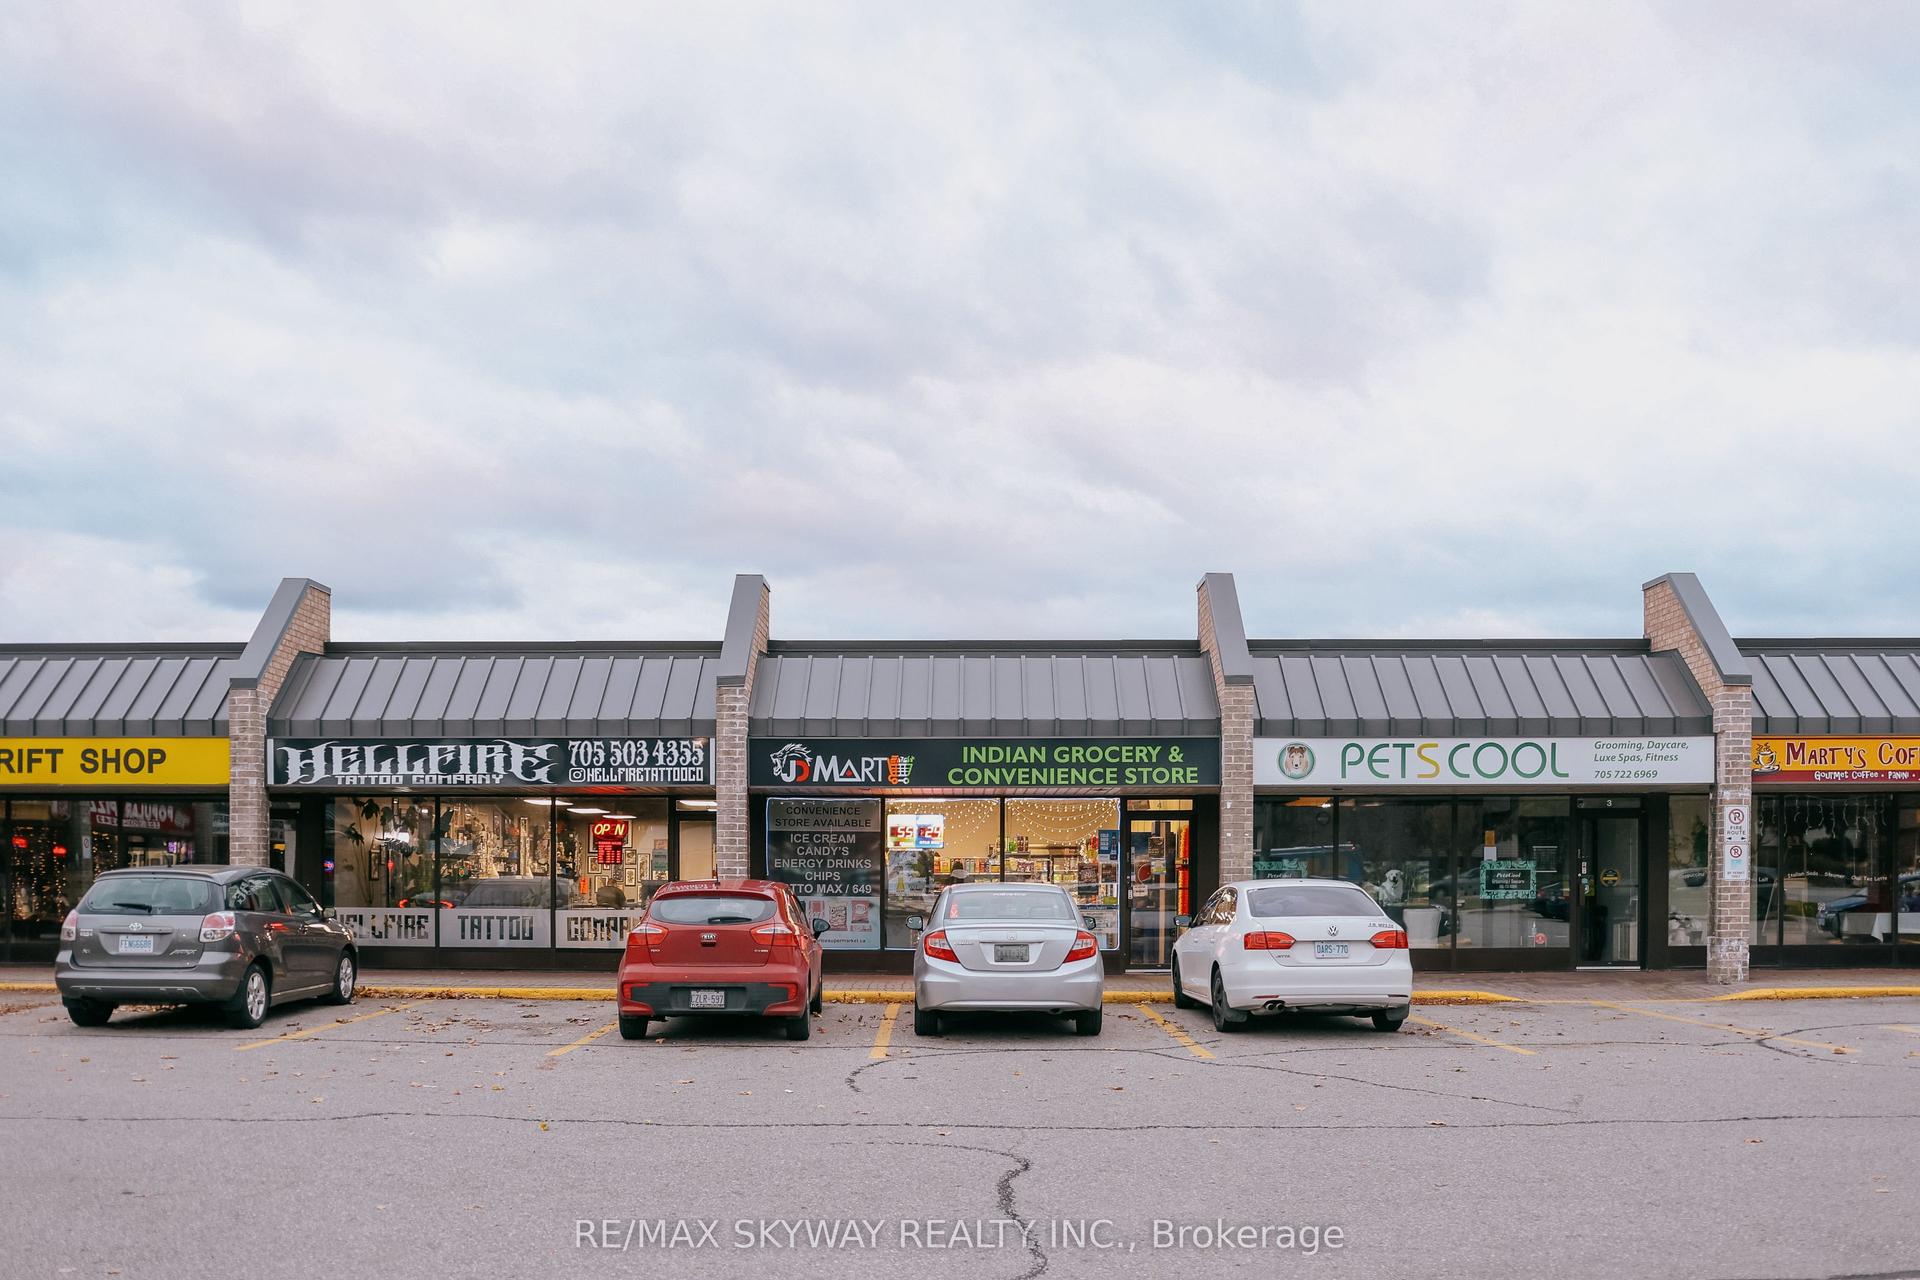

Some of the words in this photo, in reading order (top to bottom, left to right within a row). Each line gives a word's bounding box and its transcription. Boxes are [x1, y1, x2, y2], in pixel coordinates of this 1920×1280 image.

[1594, 740, 1644, 752] Grooming,
[1646, 740, 1689, 751] Daycare,
[568, 740, 605, 767] 705
[610, 740, 649, 767] 503
[652, 740, 704, 767] 4355
[962, 746, 1046, 764] INDIAN
[1053, 746, 1161, 764] GROCERY
[1168, 746, 1184, 763] &
[1594, 753, 1616, 762] Luxe
[1618, 753, 1643, 763] Spas,
[1645, 753, 1679, 762] Fitness
[1878, 742, 1920, 765] COF
[80, 748, 166, 774] SHOP
[277, 740, 559, 784] HELLFIRE
[1448, 742, 1569, 778] COOL
[587, 767, 704, 782] HELLFIRETATTOOCO
[812, 755, 889, 782] MART
[1594, 770, 1612, 779] 705
[1614, 770, 1632, 779] 722
[1633, 770, 1658, 779] 6969
[334, 775, 403, 785] TATTOO
[412, 774, 503, 785] COMPANY
[947, 767, 1118, 785] CONVENIENCE
[1125, 767, 1199, 784] STORE
[1606, 799, 1613, 807] 3
[786, 806, 861, 815] CONVENIENCE
[593, 823, 626, 836] OPN
[775, 819, 810, 827] STORE
[812, 819, 871, 828] AVAILABLE
[790, 833, 810, 843] ICE
[813, 833, 856, 844] CREAM
[796, 846, 850, 856] CANDY'S
[774, 858, 823, 868] ENERGY
[827, 858, 872, 869] DRINKS
[805, 871, 841, 881] CHIPS
[789, 883, 813, 894] TTO
[816, 883, 844, 894] MAX
[845, 883, 850, 894] /
[852, 884, 872, 894] 649
[457, 915, 534, 941] TATTOO
[566, 917, 641, 941] COMPA
